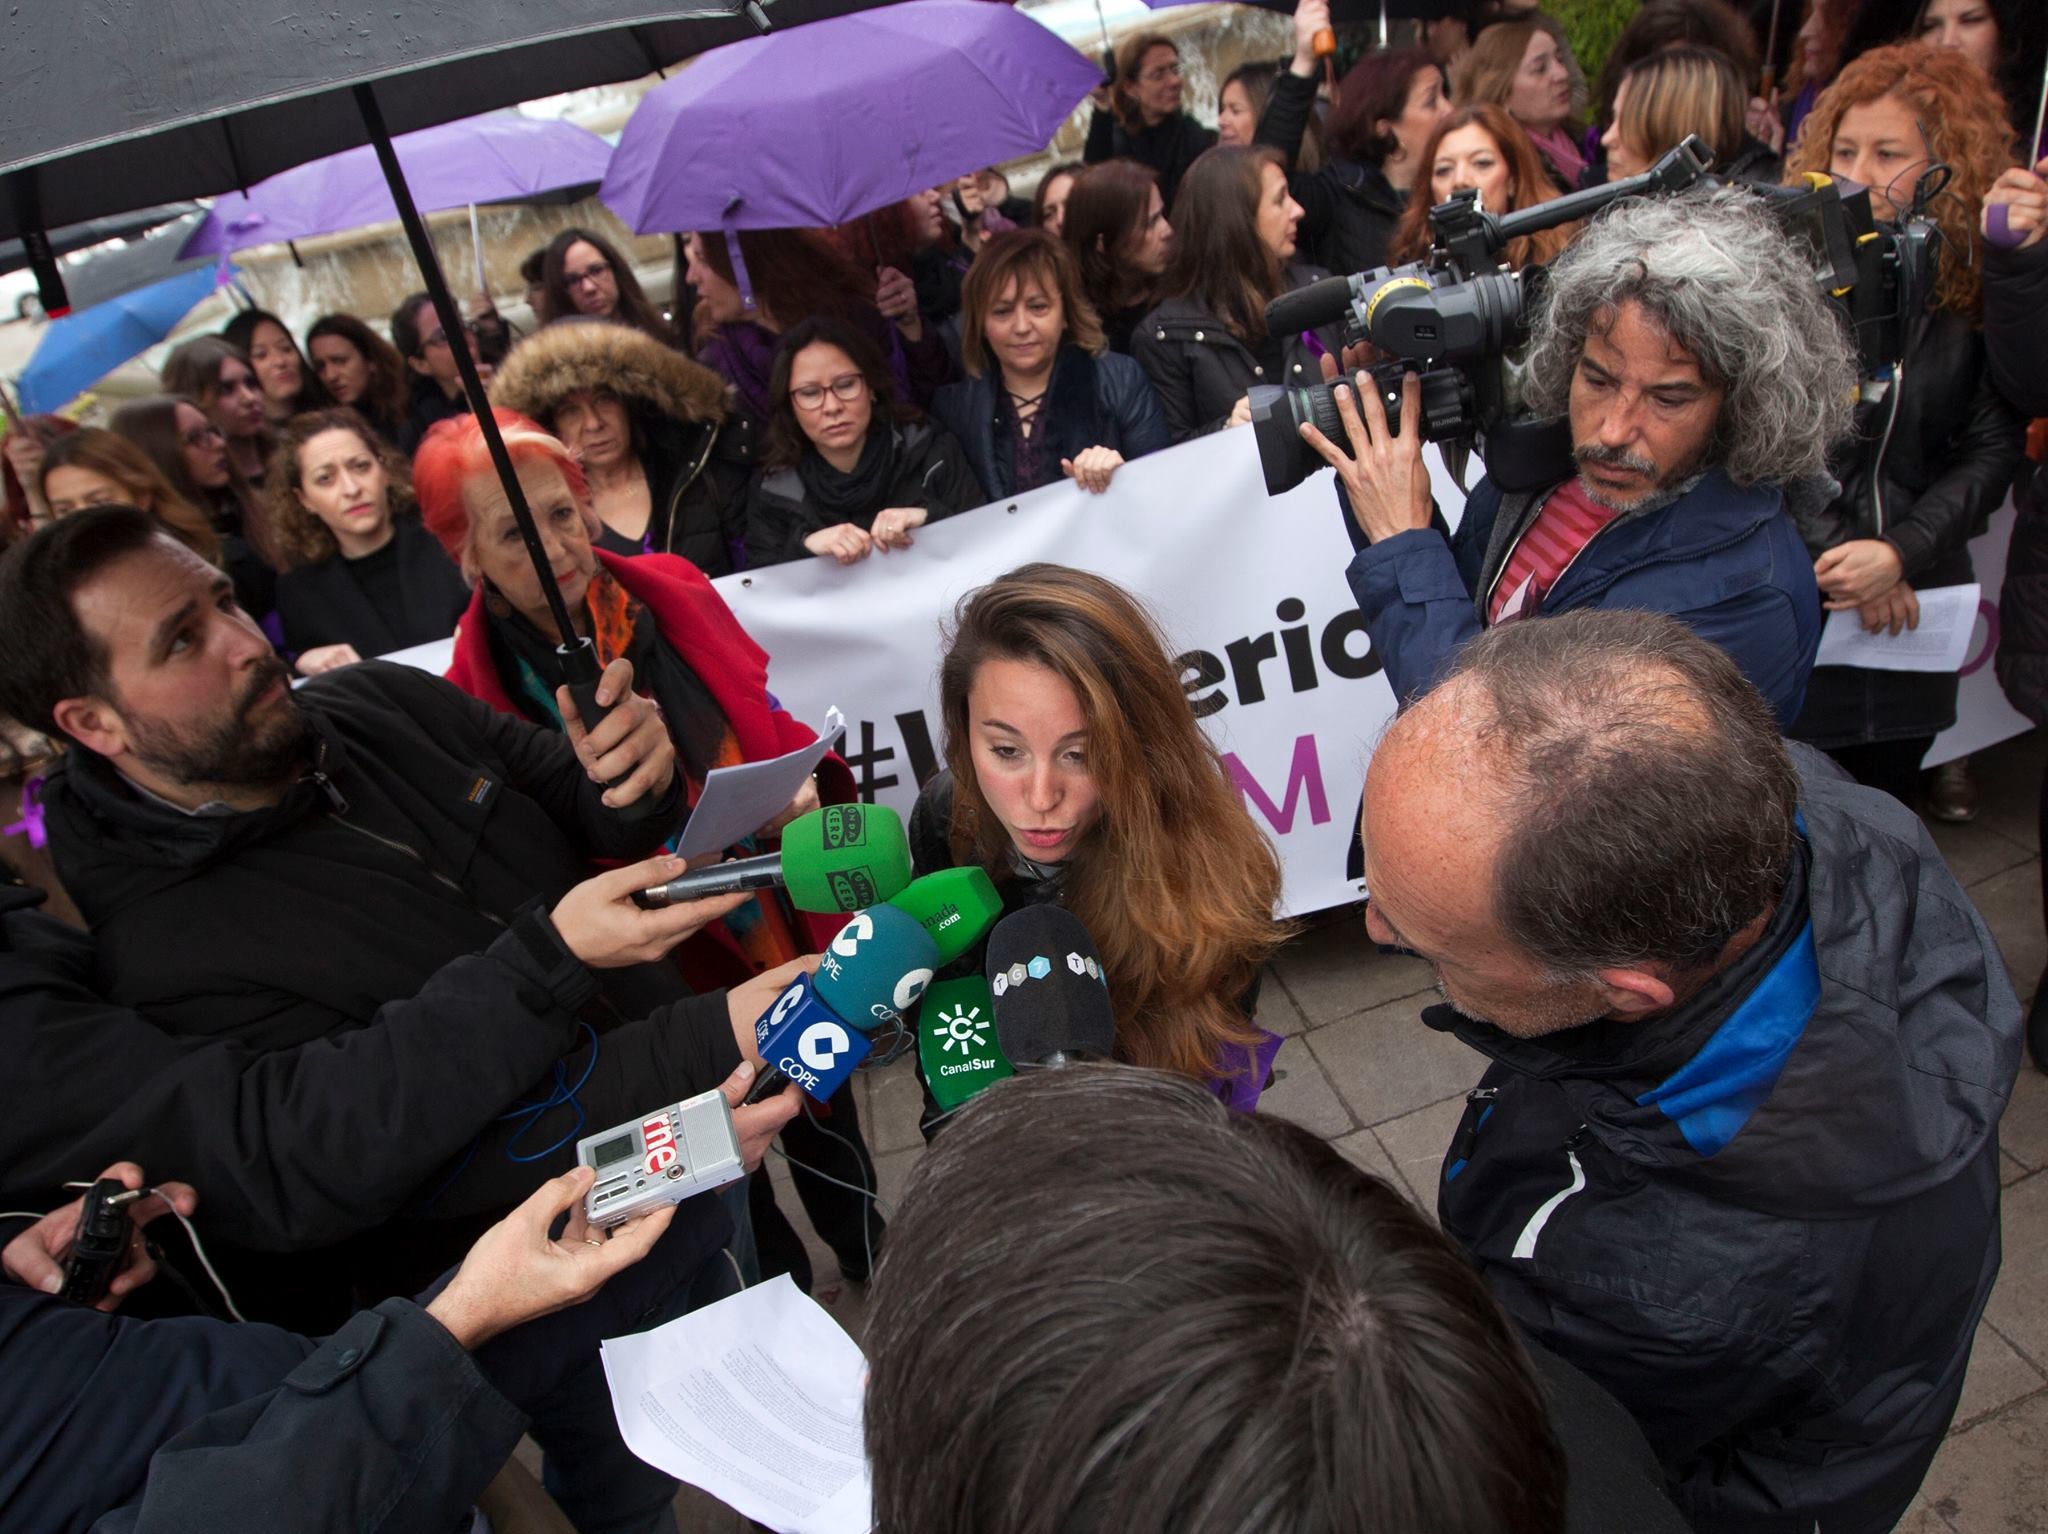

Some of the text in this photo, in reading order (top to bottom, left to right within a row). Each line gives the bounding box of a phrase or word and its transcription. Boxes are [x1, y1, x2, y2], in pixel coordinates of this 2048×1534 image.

[829, 810, 840, 841] CERO
[921, 903, 959, 929] nada
[938, 912, 961, 931] .com
[820, 951, 843, 982] OPE
[779, 1056, 820, 1091] COPE
